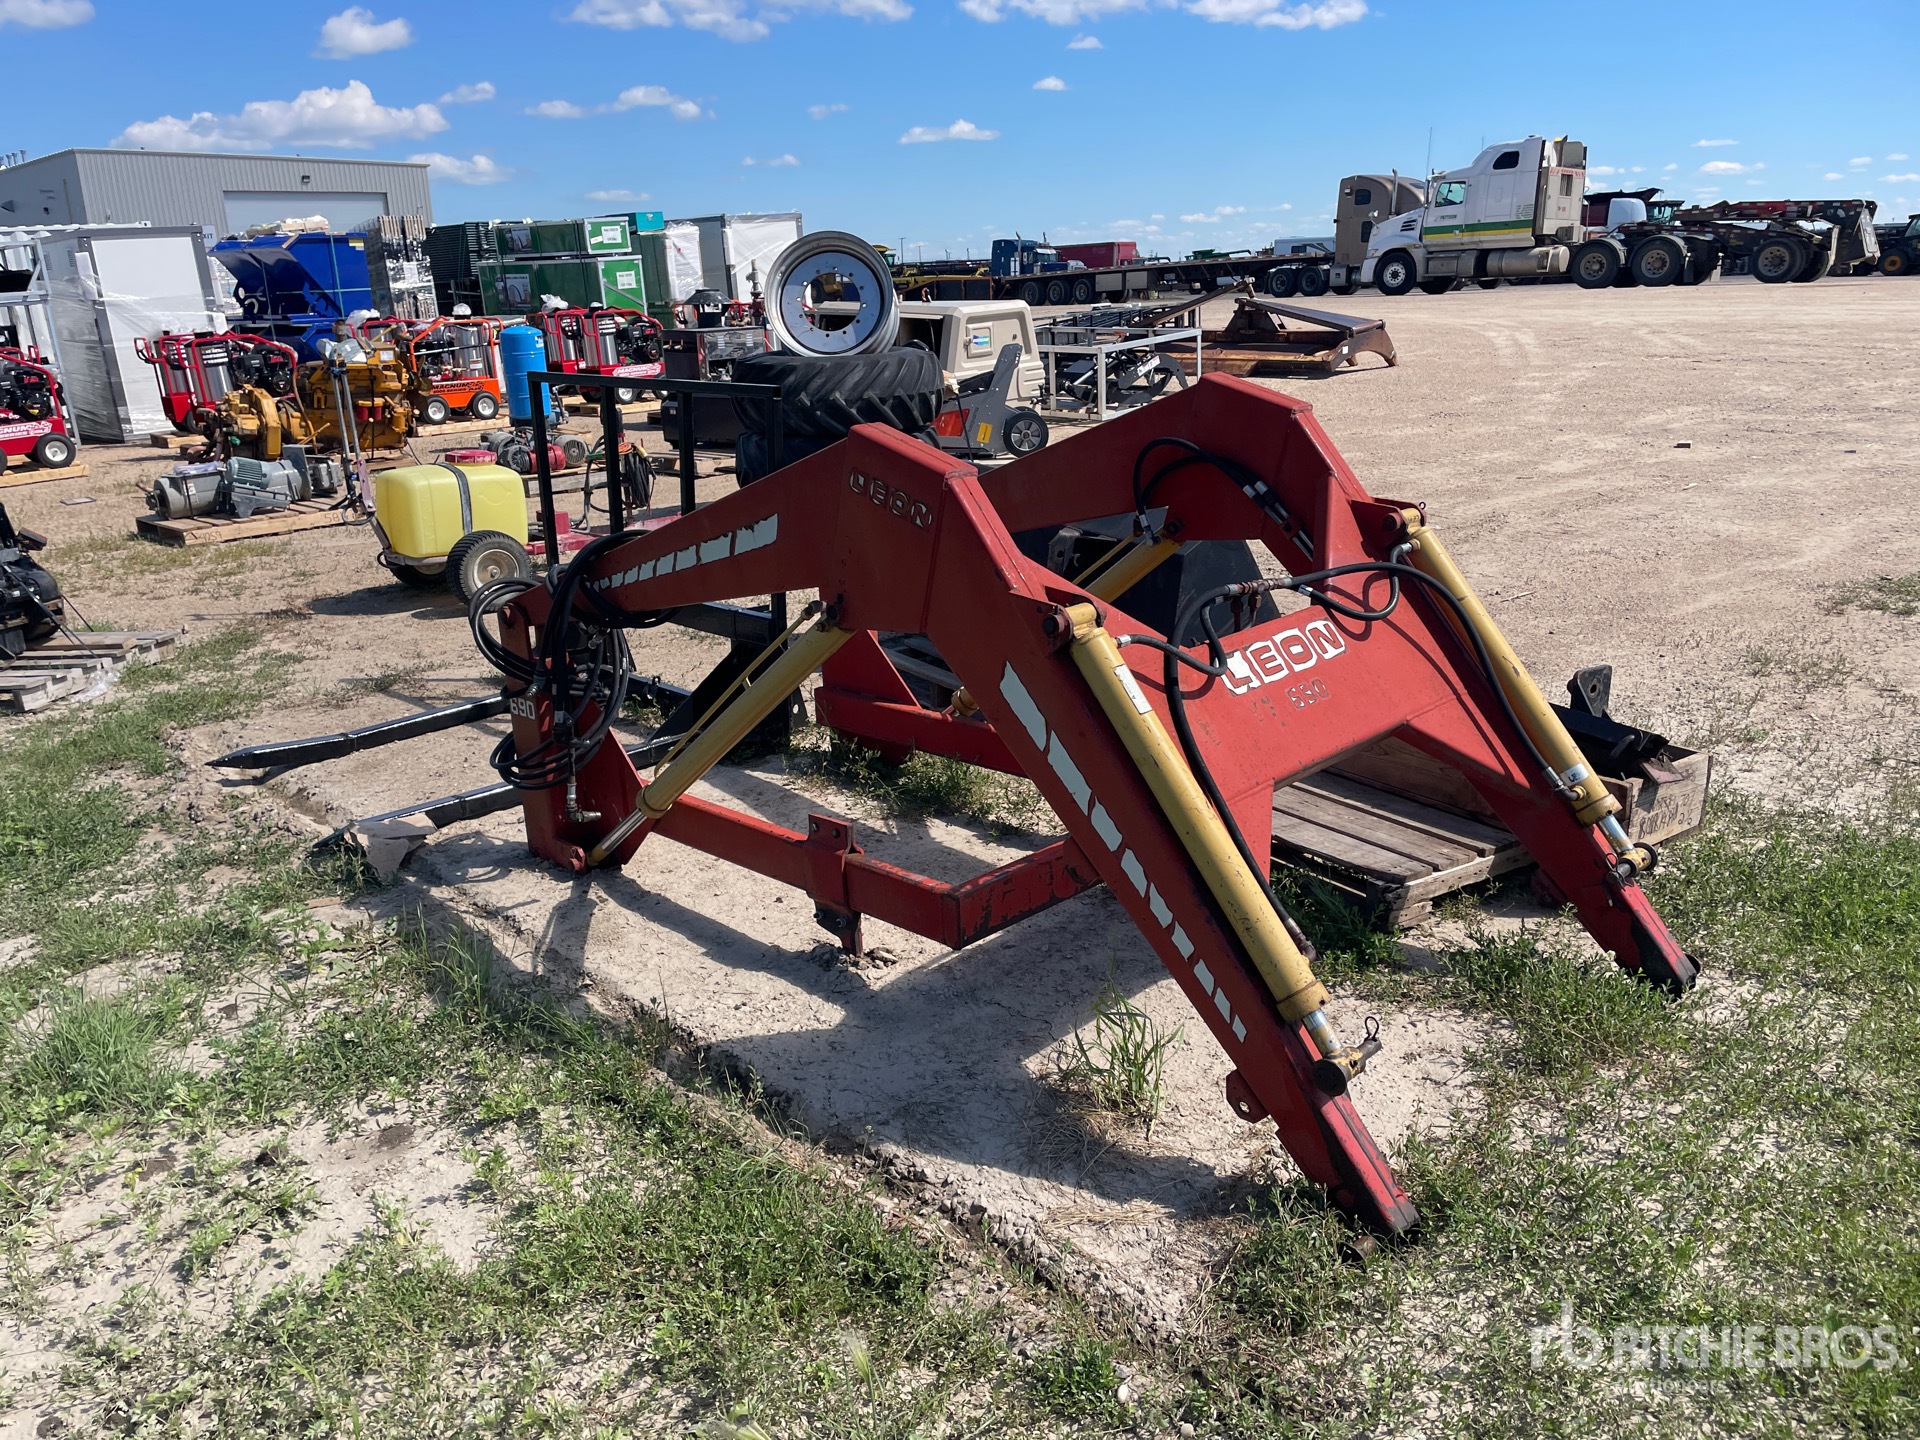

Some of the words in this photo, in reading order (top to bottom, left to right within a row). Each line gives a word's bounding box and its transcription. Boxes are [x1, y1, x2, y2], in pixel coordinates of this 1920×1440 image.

[432, 382, 469, 390] MAGNUM
[849, 467, 933, 529] LEON
[1219, 620, 1346, 697] LEON
[510, 697, 536, 720] 690
